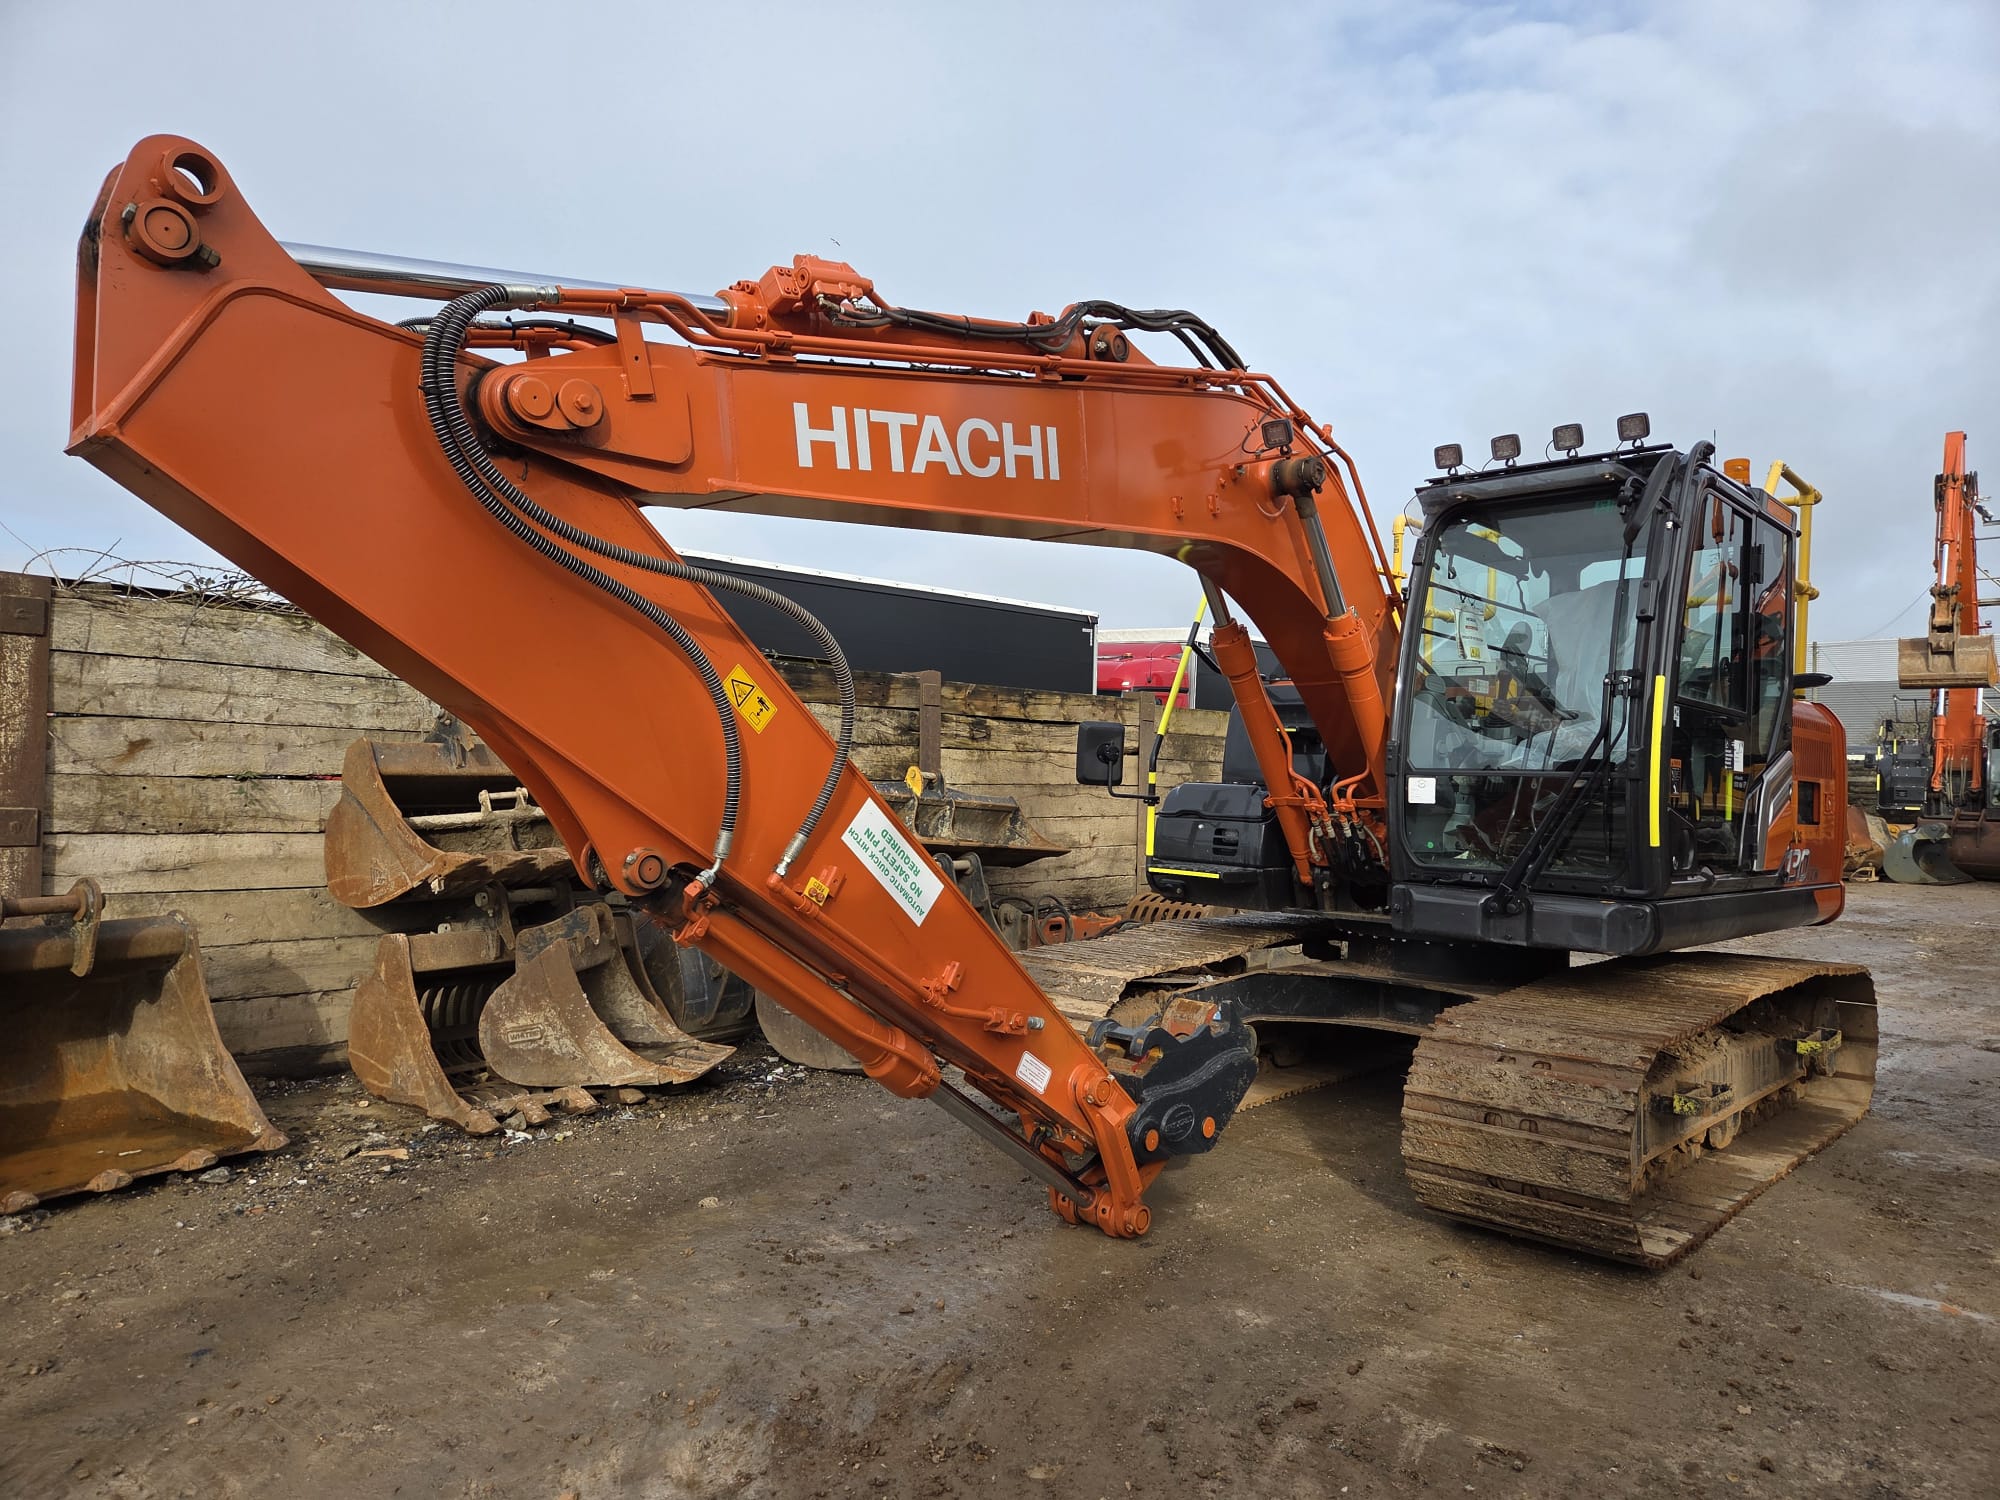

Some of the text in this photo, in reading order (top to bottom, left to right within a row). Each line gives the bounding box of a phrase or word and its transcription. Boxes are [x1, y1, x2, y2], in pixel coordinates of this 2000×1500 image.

[792, 402, 1061, 481] HITACHI
[847, 827, 925, 916] AUTOMATIC QUICK HITCH
[864, 827, 923, 898] NO SAFETY PIN
[881, 829, 920, 876] REQUIRED
